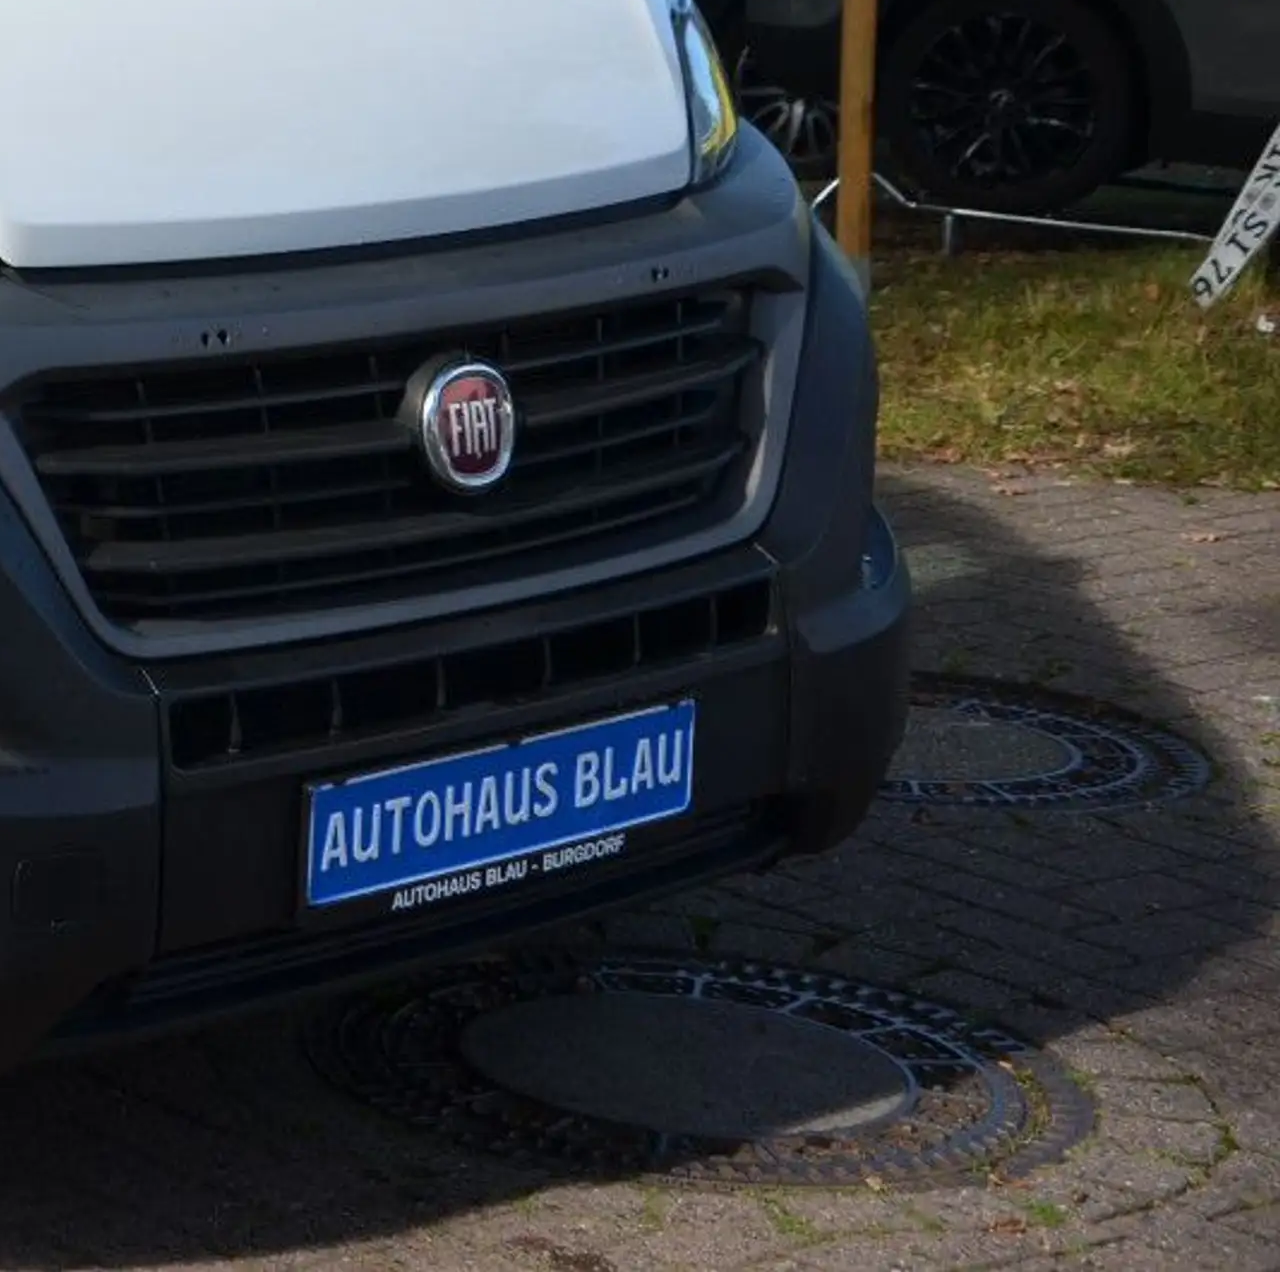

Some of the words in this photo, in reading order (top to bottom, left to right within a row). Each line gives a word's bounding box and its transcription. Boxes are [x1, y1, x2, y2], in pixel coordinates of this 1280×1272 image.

[448, 397, 498, 460] FIAT
[320, 761, 559, 873] AUTOHAUS
[574, 728, 683, 809] BLAU
[391, 875, 481, 911] AUTOHAUS
[485, 859, 528, 889] BLAU
[543, 834, 626, 873] BURGDORF
